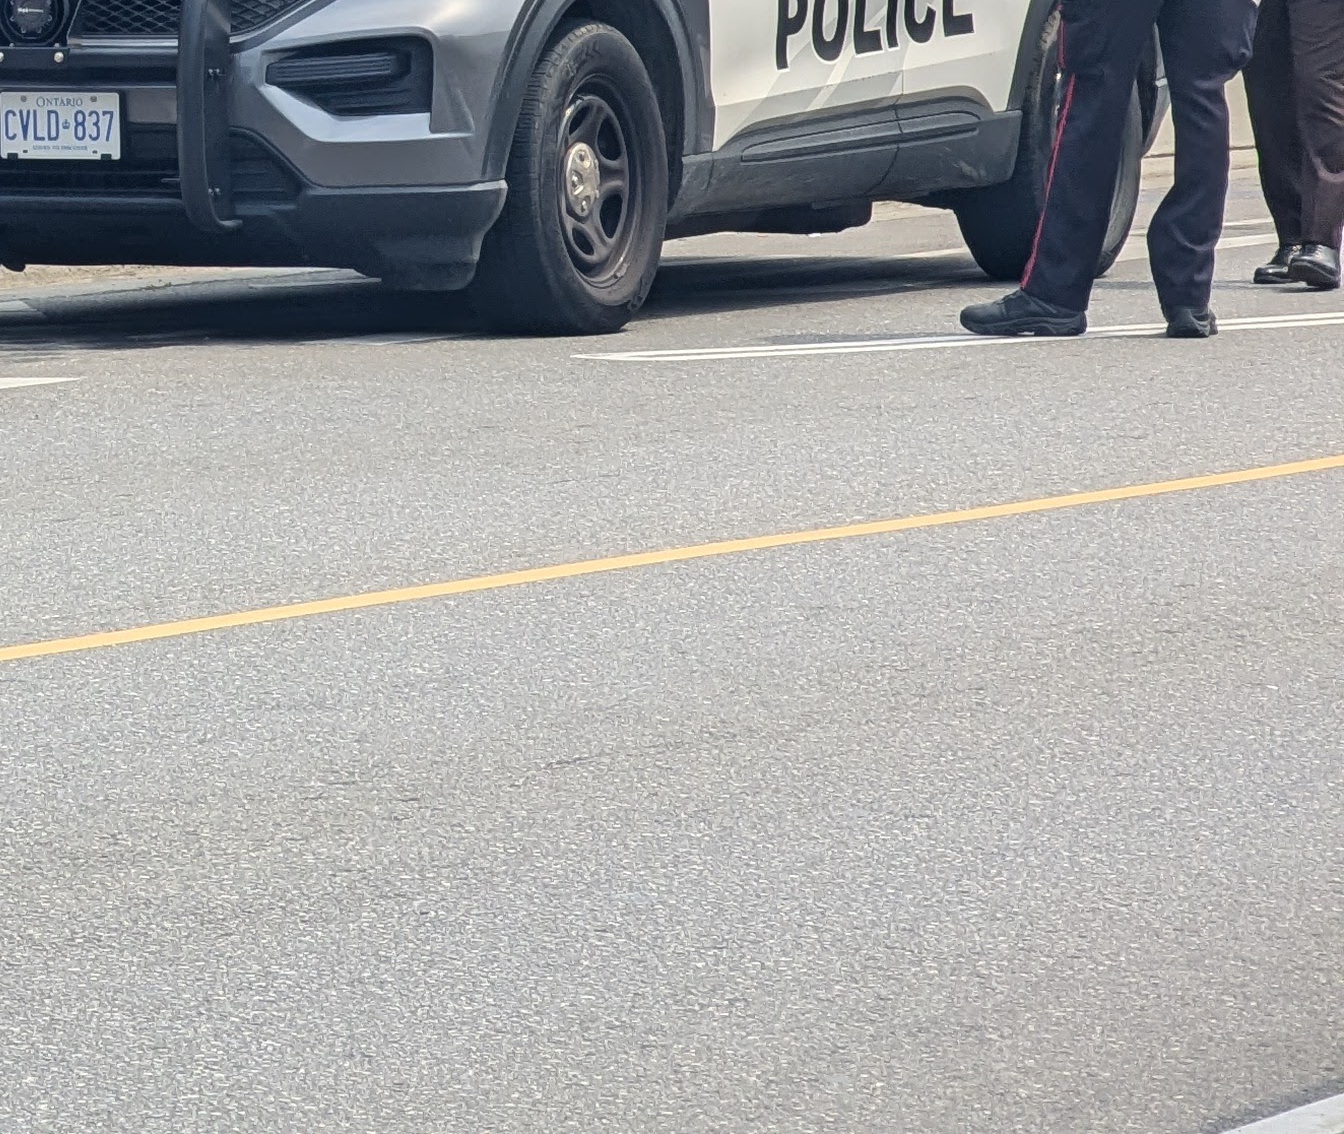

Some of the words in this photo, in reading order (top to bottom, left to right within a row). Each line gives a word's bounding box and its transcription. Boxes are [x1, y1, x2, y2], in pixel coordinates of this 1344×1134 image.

[36, 96, 83, 108] ONTARIO
[4, 108, 60, 142] CVLD
[73, 109, 115, 142] 837
